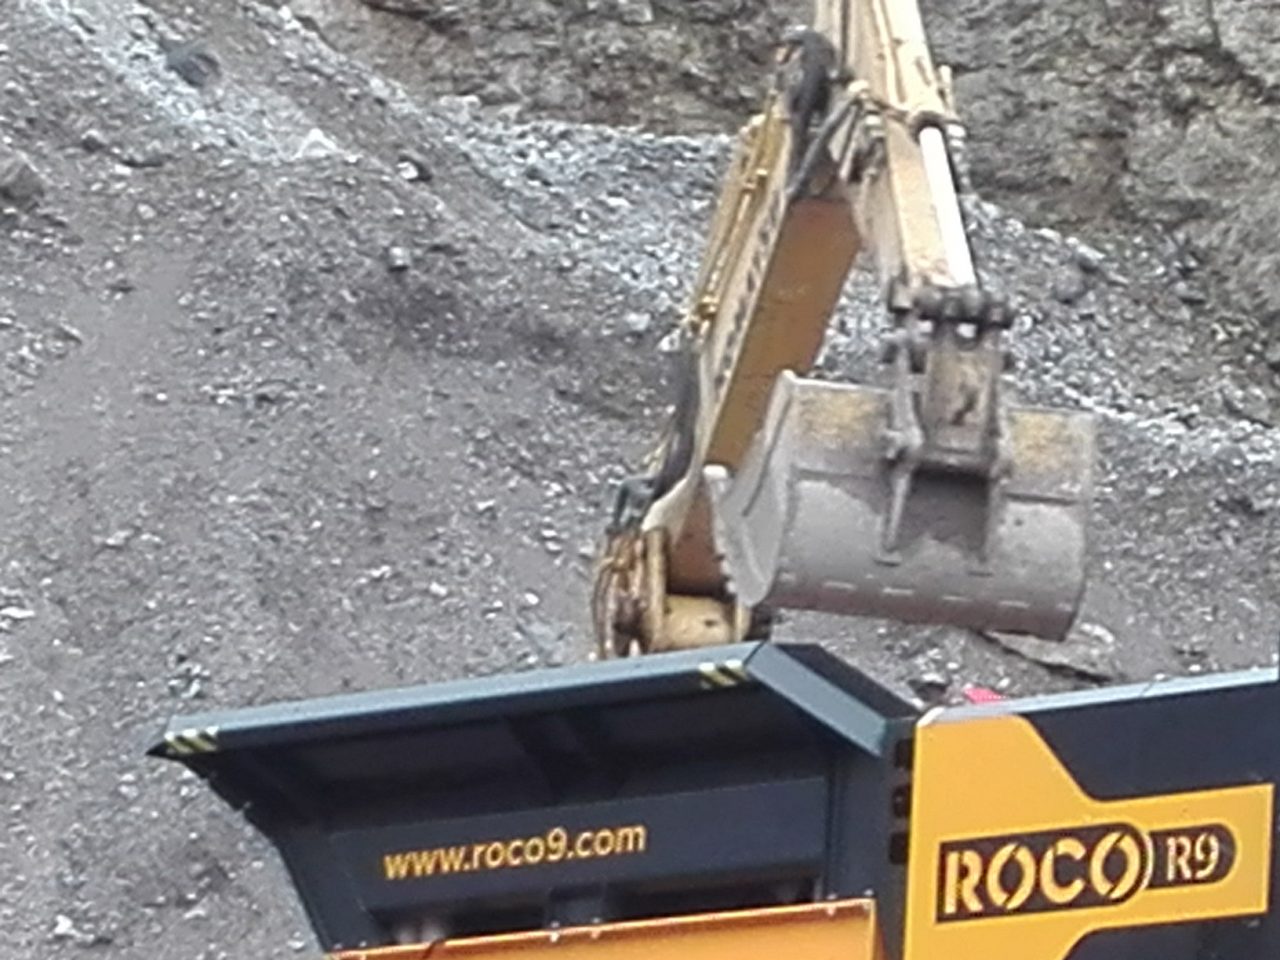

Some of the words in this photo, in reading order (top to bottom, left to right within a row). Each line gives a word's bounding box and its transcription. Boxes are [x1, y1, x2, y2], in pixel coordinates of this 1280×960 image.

[383, 824, 648, 881] www.roco9.com
[944, 831, 1142, 915] ROCO
[1166, 832, 1221, 882] R9
